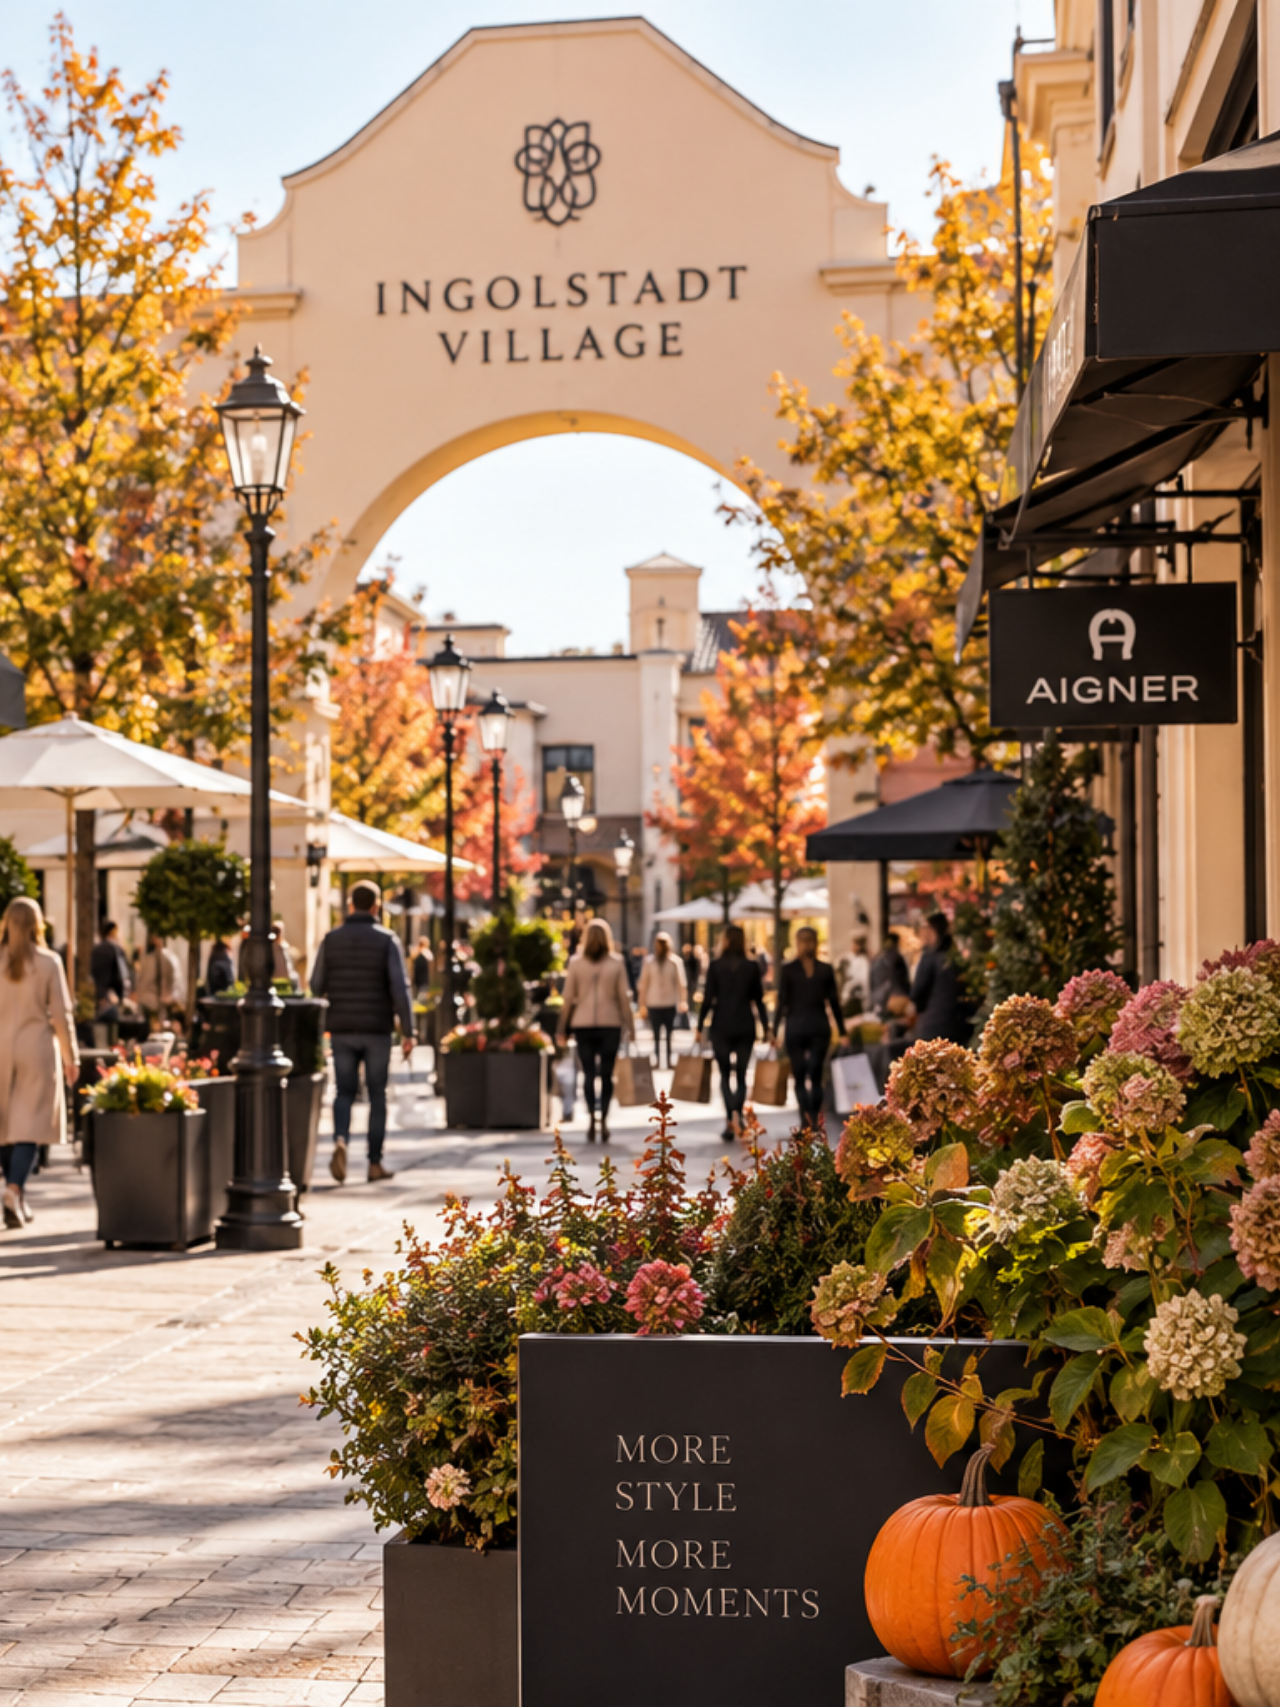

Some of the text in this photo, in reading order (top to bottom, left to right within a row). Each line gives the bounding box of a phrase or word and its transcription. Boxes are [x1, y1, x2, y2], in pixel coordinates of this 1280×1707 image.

[376, 265, 747, 315] INGOLSTADT
[438, 321, 682, 364] VILLAGE
[1027, 676, 1199, 705] AIGNER
[616, 1434, 731, 1464] MORE
[615, 1481, 737, 1512] STYLE
[616, 1539, 731, 1568] MORE
[616, 1586, 819, 1618] MOMENTS
